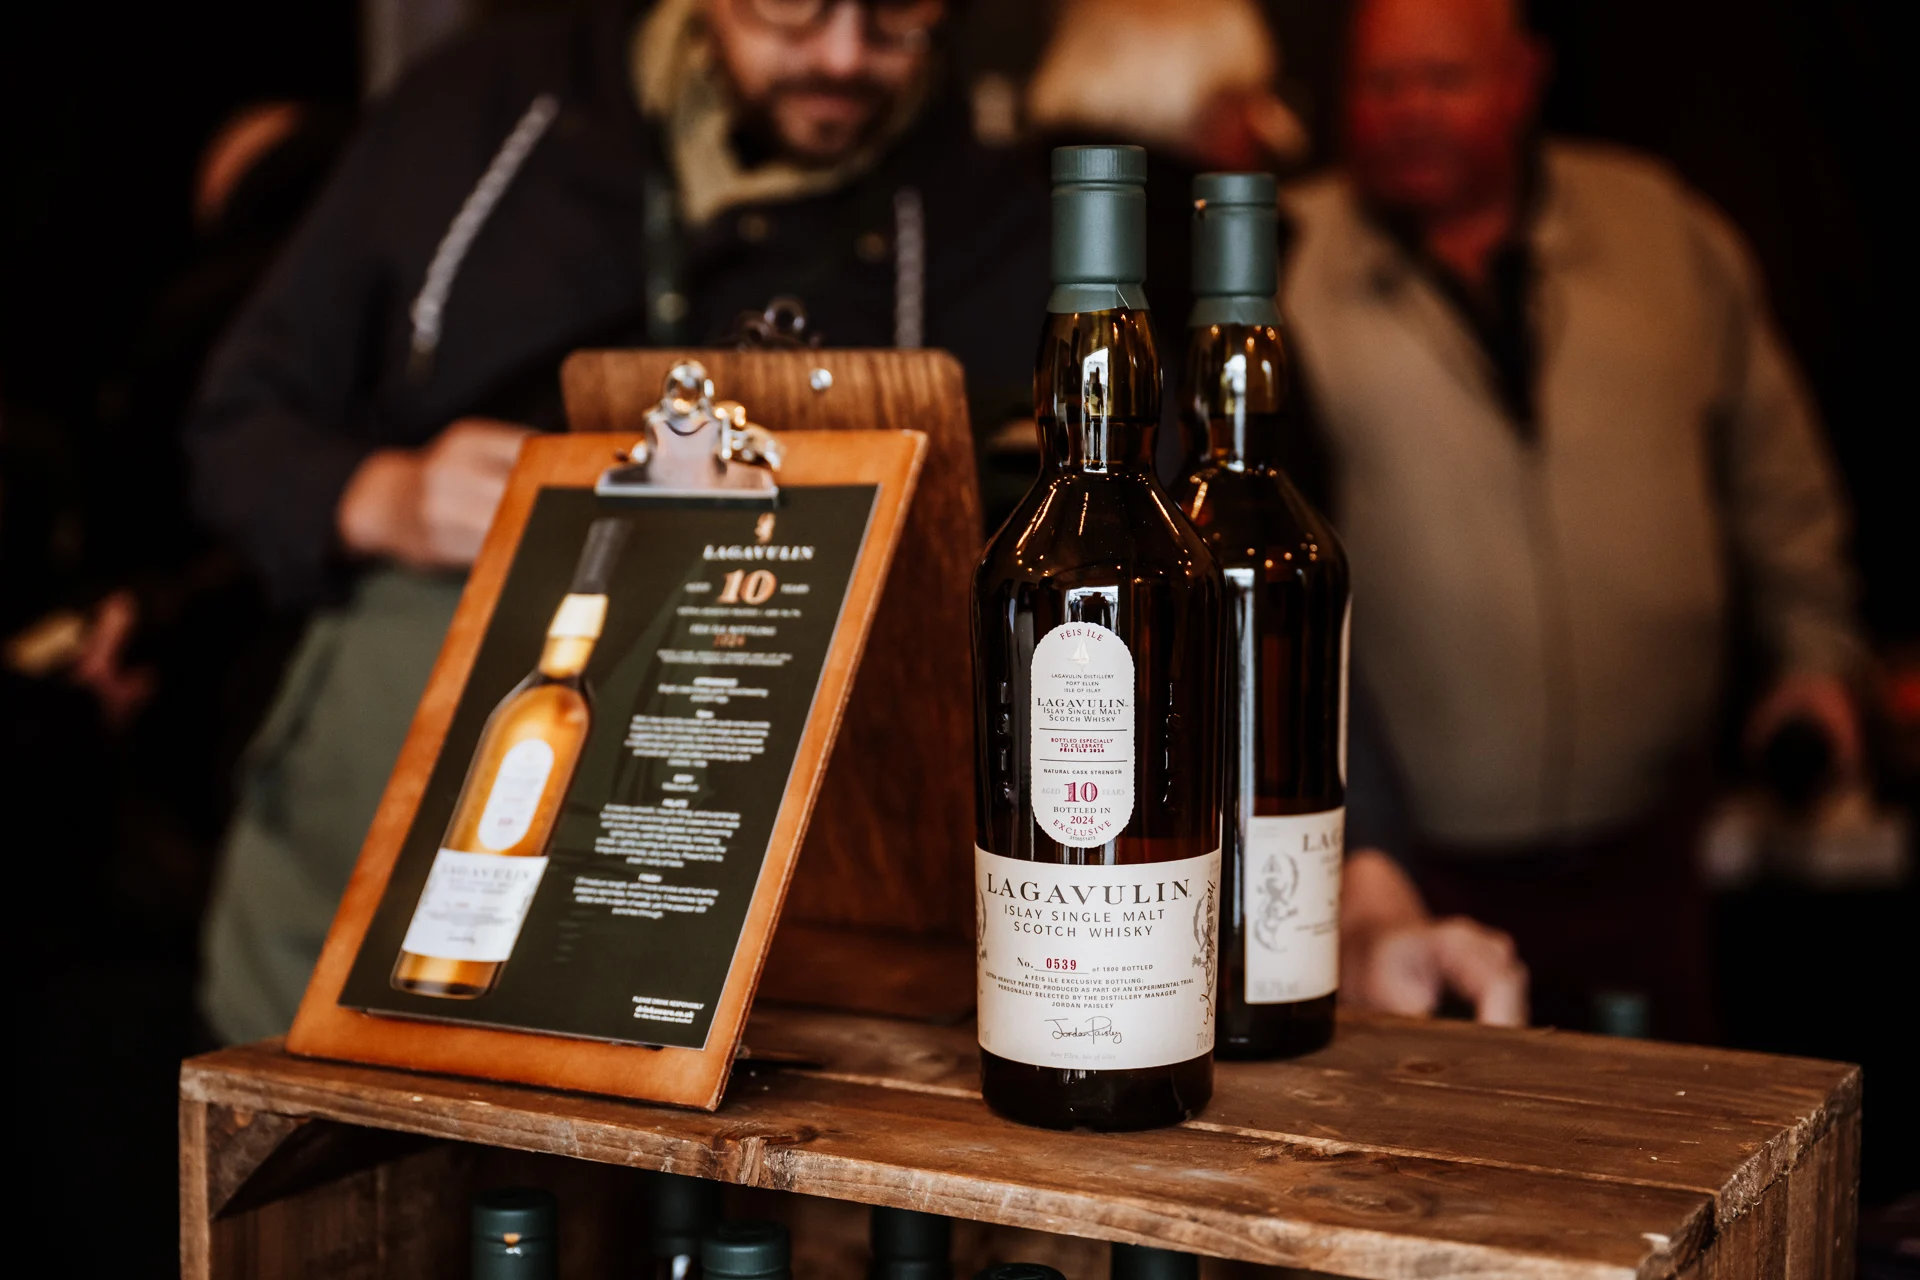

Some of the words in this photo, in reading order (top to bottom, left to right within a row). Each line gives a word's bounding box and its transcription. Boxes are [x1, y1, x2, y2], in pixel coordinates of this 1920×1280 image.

[717, 569, 777, 605] 10
[1037, 698, 1125, 707] LAGAVULIN
[1064, 782, 1098, 803] 10
[1053, 806, 1097, 814] BOTTLED
[1053, 819, 1112, 837] EXCLUSIVE
[1070, 815, 1094, 825] 2024
[987, 873, 1189, 905] LAGAVULIN
[1004, 904, 1042, 919] ISLAY
[1051, 911, 1111, 922] SINGLE
[1123, 909, 1164, 922] MALT
[1014, 921, 1076, 937] SCOTCH
[1089, 925, 1153, 938] WHISKY
[1017, 957, 1034, 969] No.
[1046, 957, 1077, 971] 0539
[1122, 964, 1153, 972] BOTTLED
[998, 976, 1016, 985] HEAVILY
[1043, 985, 1079, 993] PRODUCED
[1134, 982, 1180, 991] EXPERIMENTAL
[1180, 978, 1194, 986] TRIAL
[998, 984, 1032, 996] PERSONALLY
[1035, 992, 1070, 1000] SELECTED
[1144, 989, 1177, 999] MANAGER
